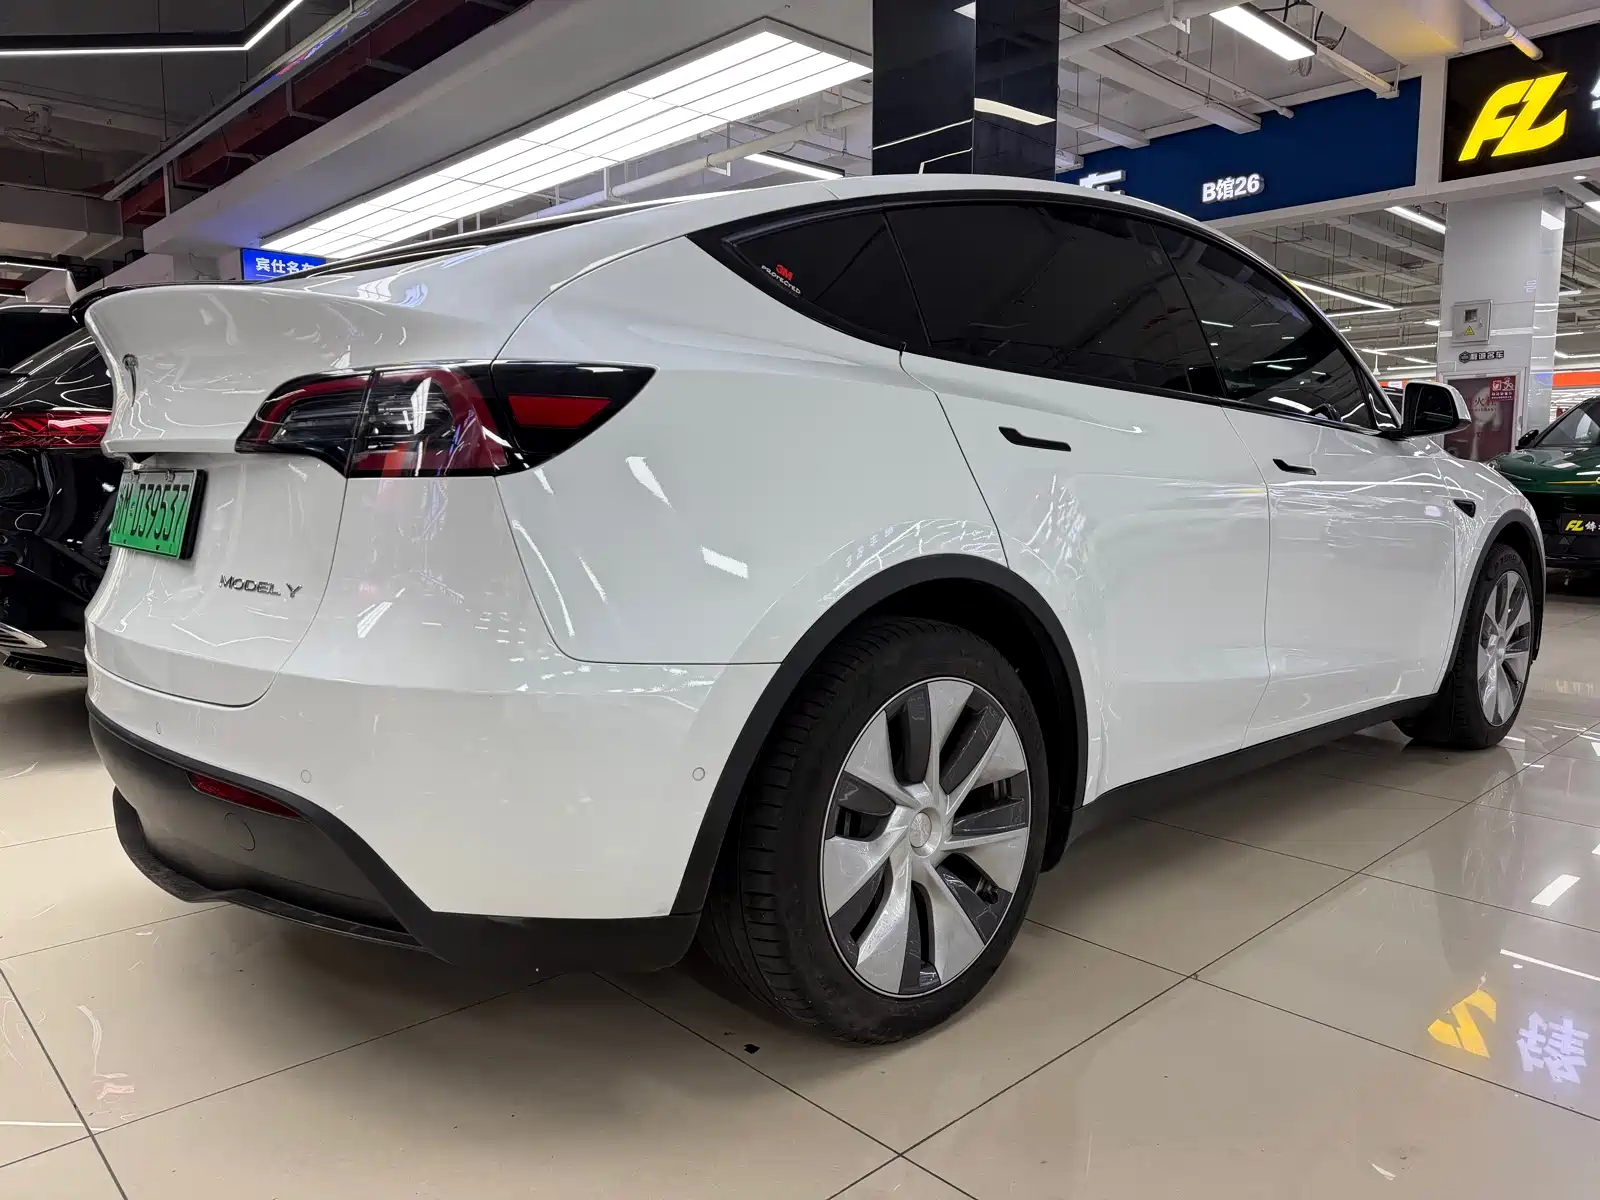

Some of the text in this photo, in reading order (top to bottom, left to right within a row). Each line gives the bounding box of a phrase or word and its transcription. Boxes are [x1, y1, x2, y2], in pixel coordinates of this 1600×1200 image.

[1201, 172, 1262, 203] B馆26
[761, 264, 801, 294] PROTECTED
[776, 264, 793, 281] 3M
[1584, 520, 1600, 532] 锋
[219, 574, 303, 598] MODEL Y
